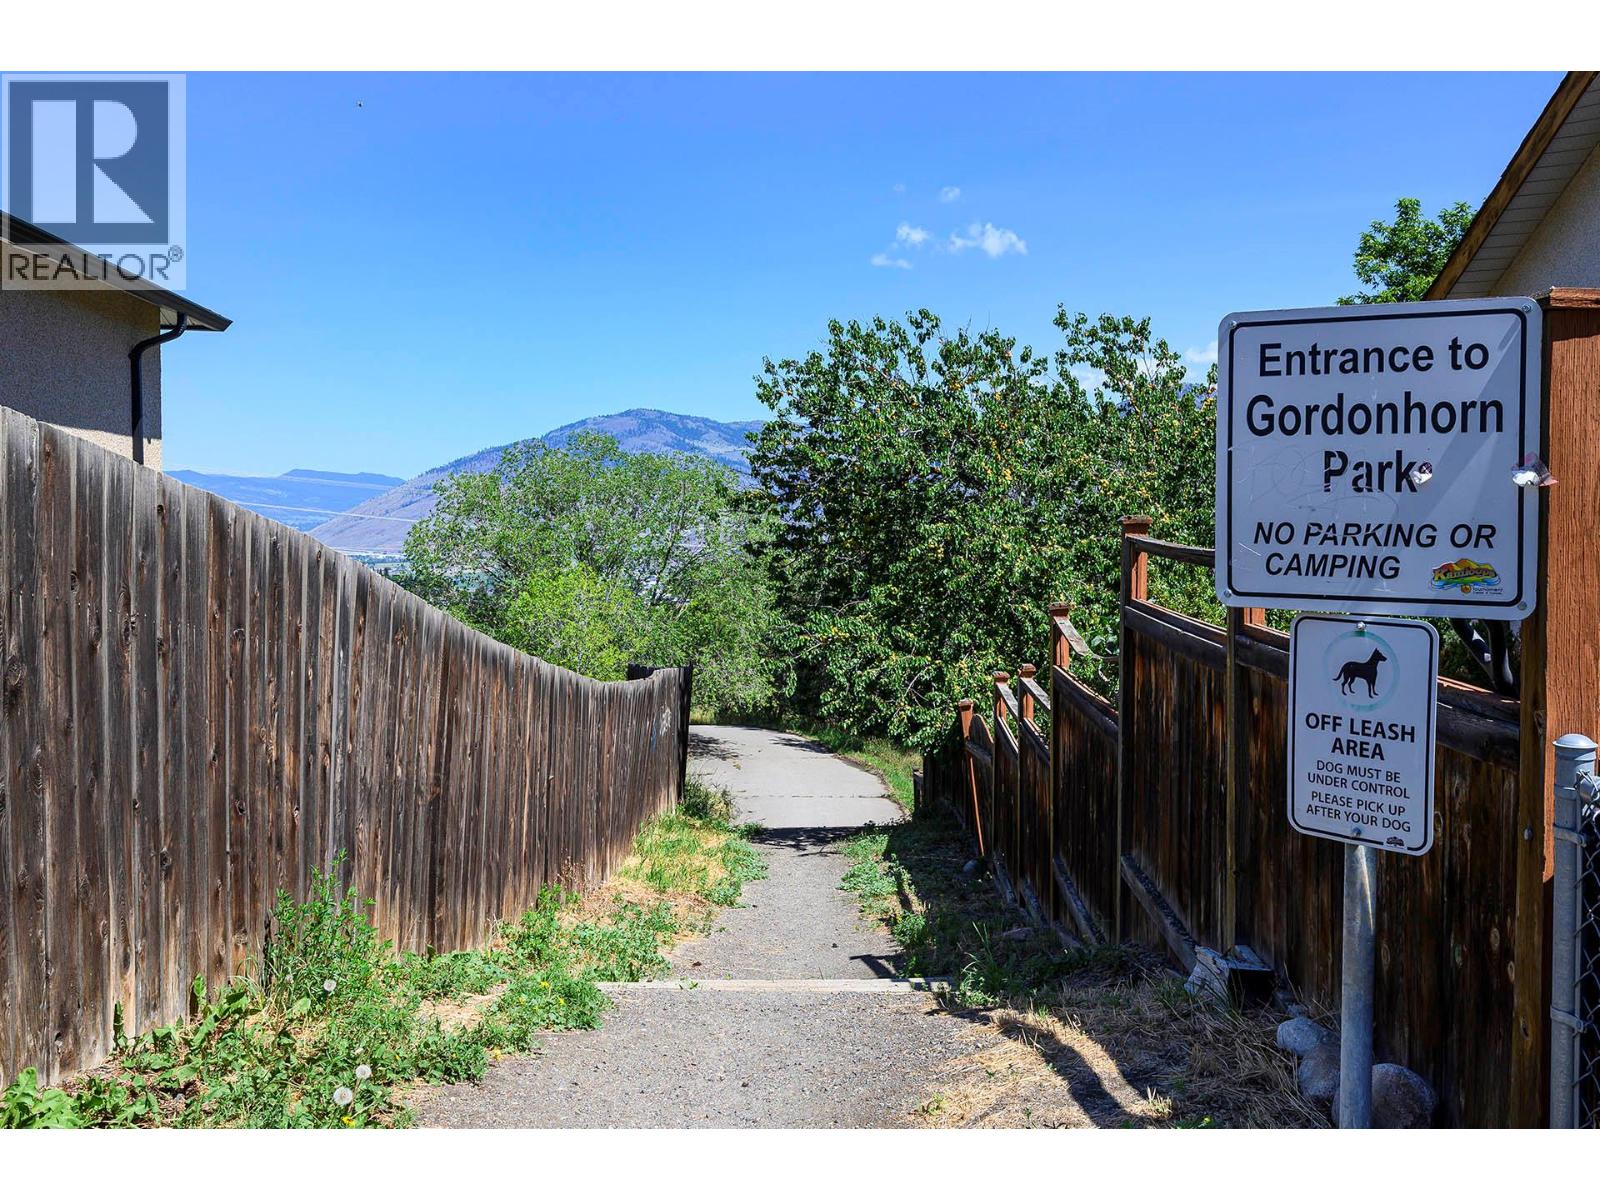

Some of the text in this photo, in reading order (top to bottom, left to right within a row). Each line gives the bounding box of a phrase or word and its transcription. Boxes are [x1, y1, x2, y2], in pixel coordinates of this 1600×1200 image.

[1259, 337, 1489, 376] Entrance to
[1247, 391, 1503, 436] Gordonhorn
[1324, 450, 1418, 493] Park
[1254, 522, 1496, 548] NO PARKING OR
[1266, 553, 1400, 579] CAMPING
[1305, 713, 1415, 743] OFF LEASH
[1331, 738, 1385, 760] AREA
[1317, 760, 1401, 783] DOG MUST BE
[1308, 773, 1410, 799] UNDER CONTROL
[1312, 791, 1405, 816] PLEASE PICK UP
[1306, 804, 1411, 832] AFTER YOUR DOG
